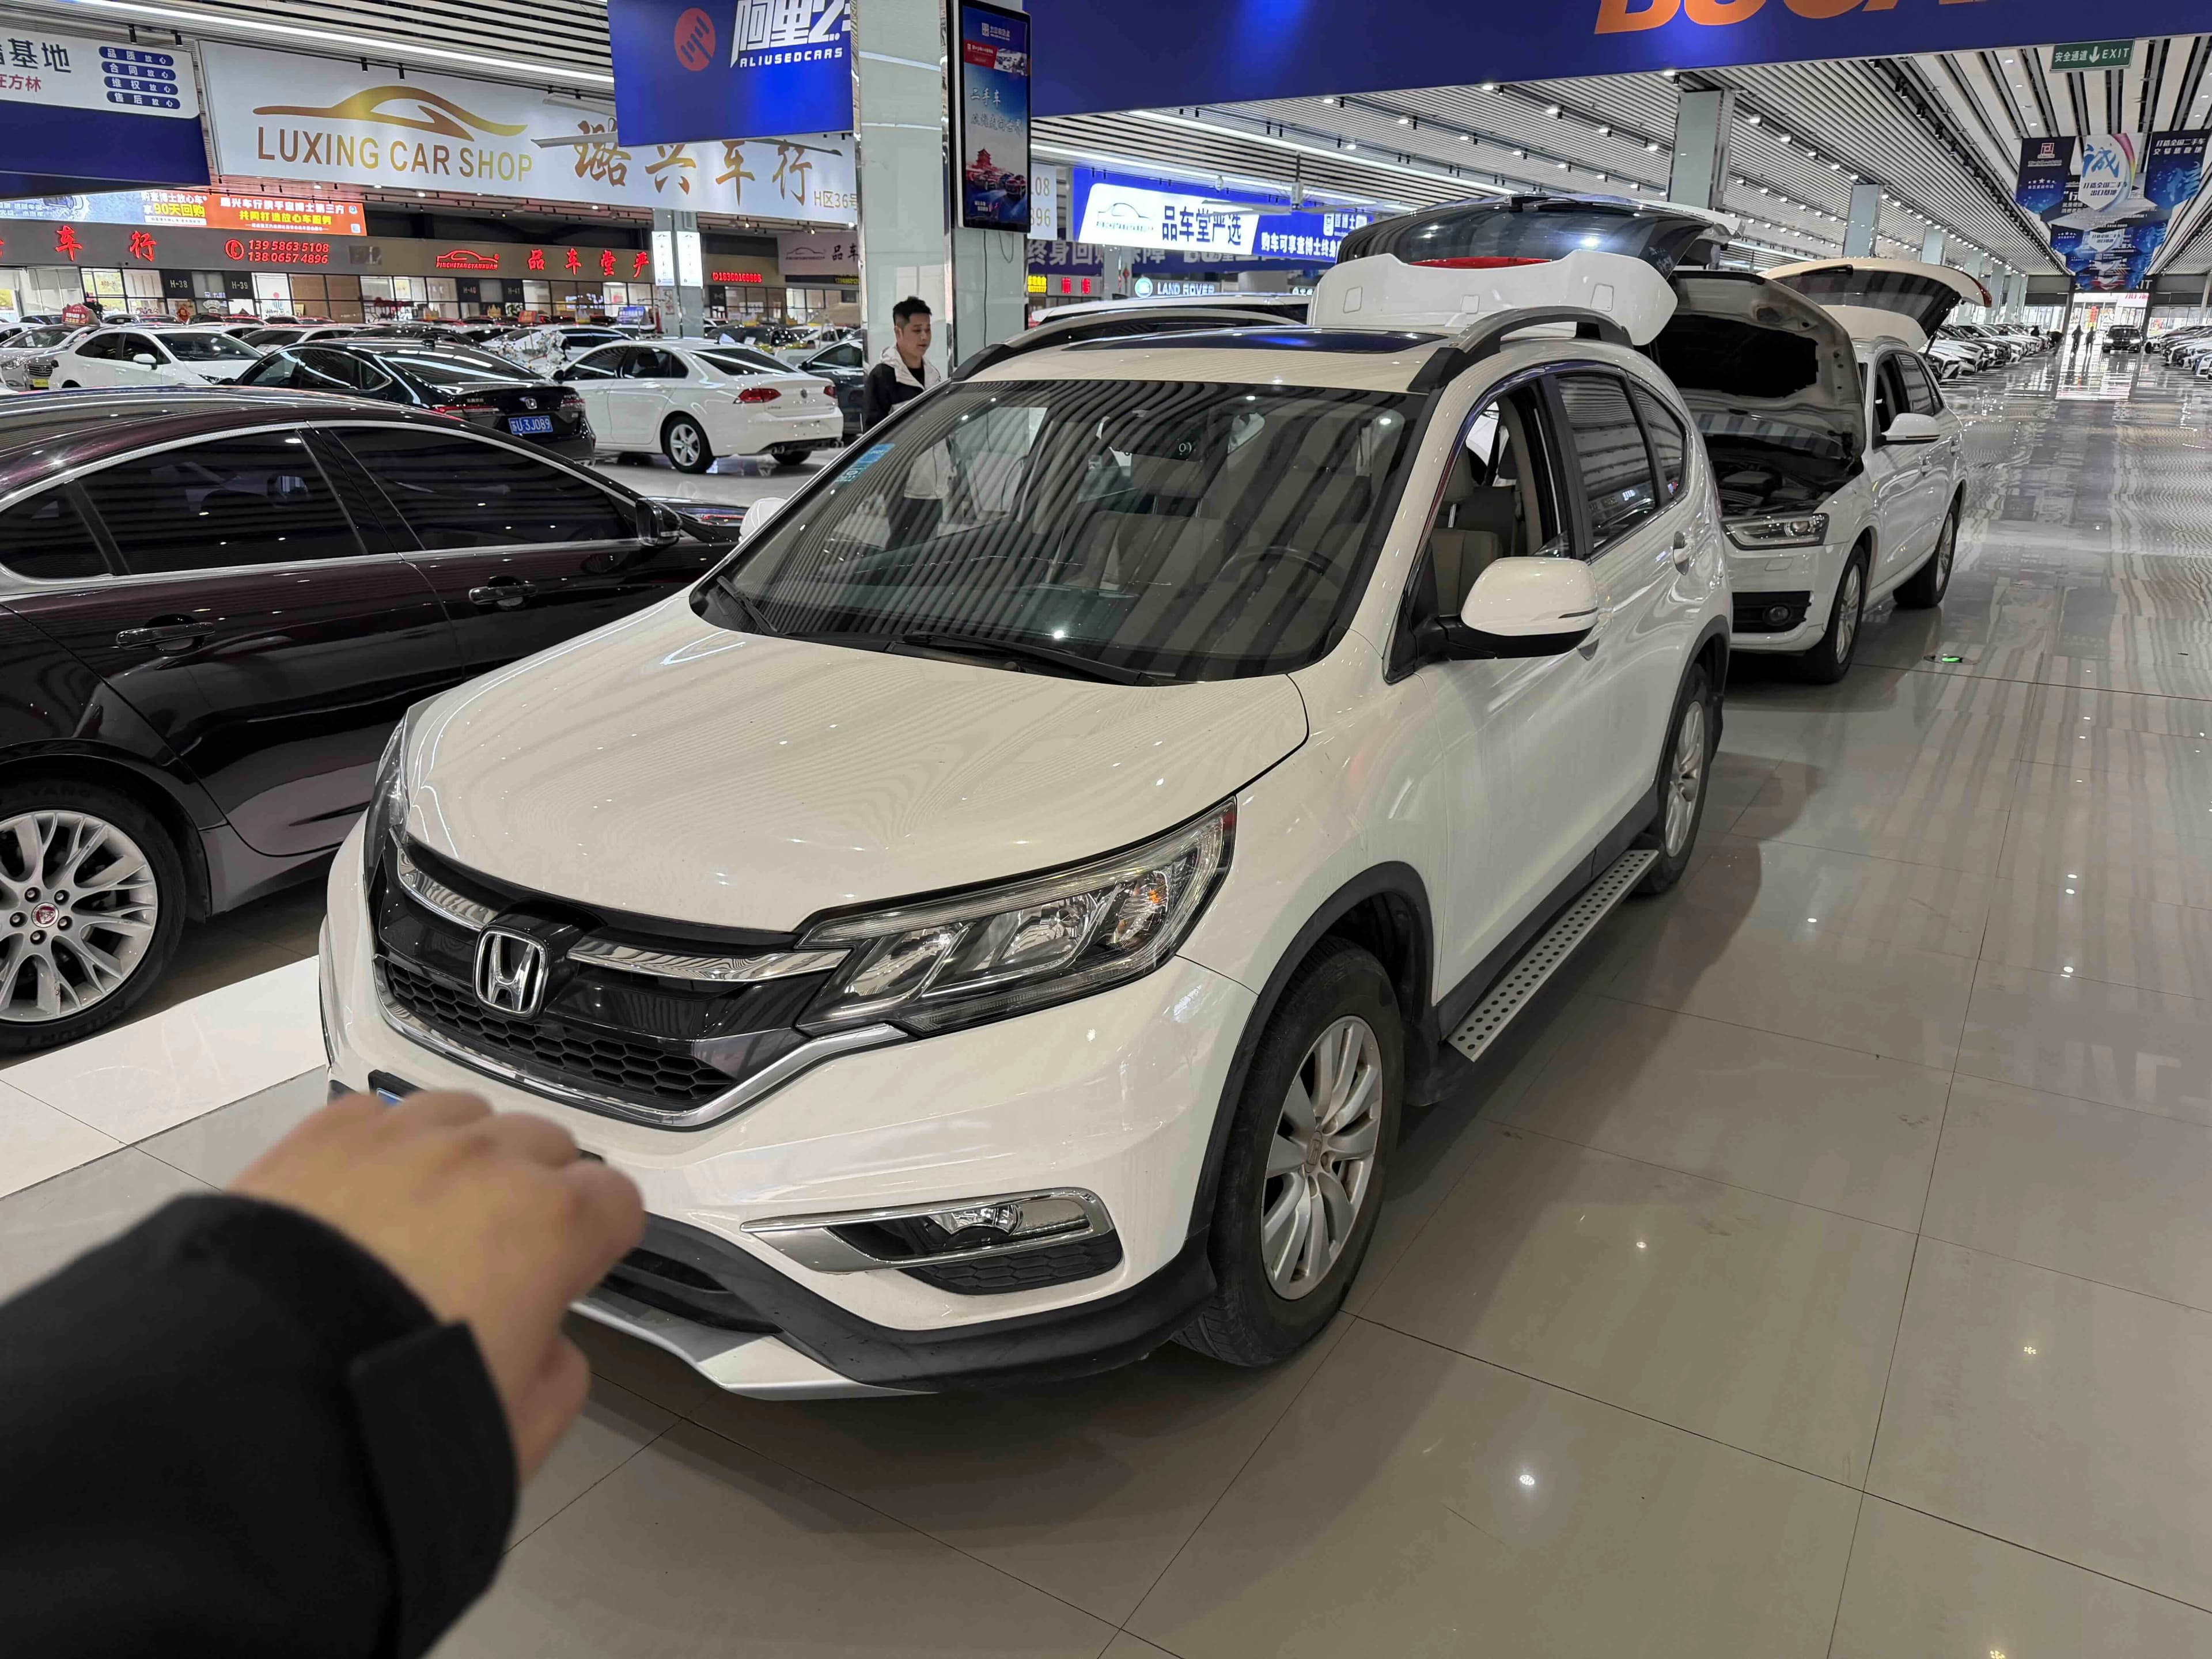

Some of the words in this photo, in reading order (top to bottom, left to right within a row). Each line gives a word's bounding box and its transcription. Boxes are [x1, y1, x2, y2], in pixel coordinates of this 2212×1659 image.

[107, 48, 166, 65] 品质放心
[740, 47, 843, 68] ALIUSEDCARS
[2055, 51, 2088, 62] 安全通道
[2102, 48, 2130, 59] EXIT
[109, 63, 169, 79] 合同放心
[112, 78, 171, 93] 维权放心
[115, 92, 173, 107] 售后放心
[971, 88, 1001, 107] 二手车
[257, 126, 380, 169] LUXING
[390, 140, 451, 176] CAR
[460, 147, 532, 182] SHOP
[1031, 176, 1050, 196] 08
[1162, 206, 1241, 246] 品车堂严选
[249, 239, 269, 250] 139
[271, 241, 298, 251] 5863
[301, 243, 329, 252] 5108
[1261, 232, 1342, 258] 购车可享查博士终身
[248, 251, 270, 262] 138
[271, 252, 299, 263] 0657
[300, 253, 328, 264] 4896
[528, 248, 650, 278] 品车堂严
[170, 279, 188, 289] H-38
[232, 281, 248, 289] H-39
[1157, 282, 1180, 296] LAND
[1183, 282, 1215, 296] ROVER
